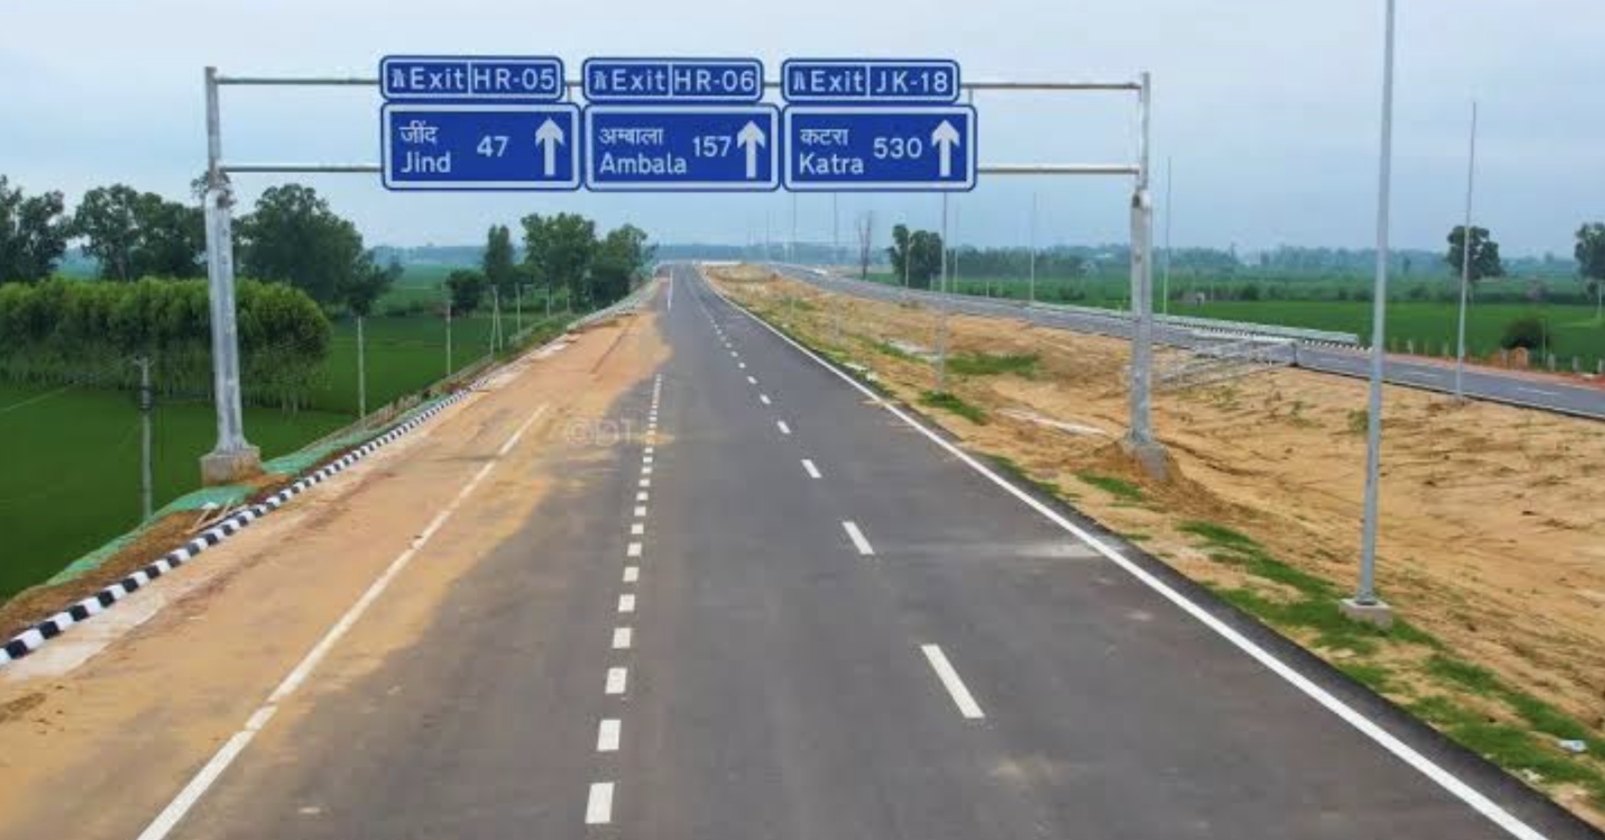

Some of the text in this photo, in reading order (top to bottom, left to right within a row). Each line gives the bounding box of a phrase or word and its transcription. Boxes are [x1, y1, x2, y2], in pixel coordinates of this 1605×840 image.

[409, 66, 555, 90] Exit HR-05
[612, 68, 756, 91] Exit HR-06
[810, 70, 949, 92] Exit JK-18
[399, 119, 438, 143] जींद
[599, 128, 664, 145] अम्बाला
[800, 128, 849, 145] कटरा
[476, 136, 508, 156] 47
[693, 136, 732, 157] 157
[873, 138, 923, 159] 530
[401, 151, 451, 172] Jind
[599, 153, 686, 174] Ambala
[800, 153, 863, 174] Katra
